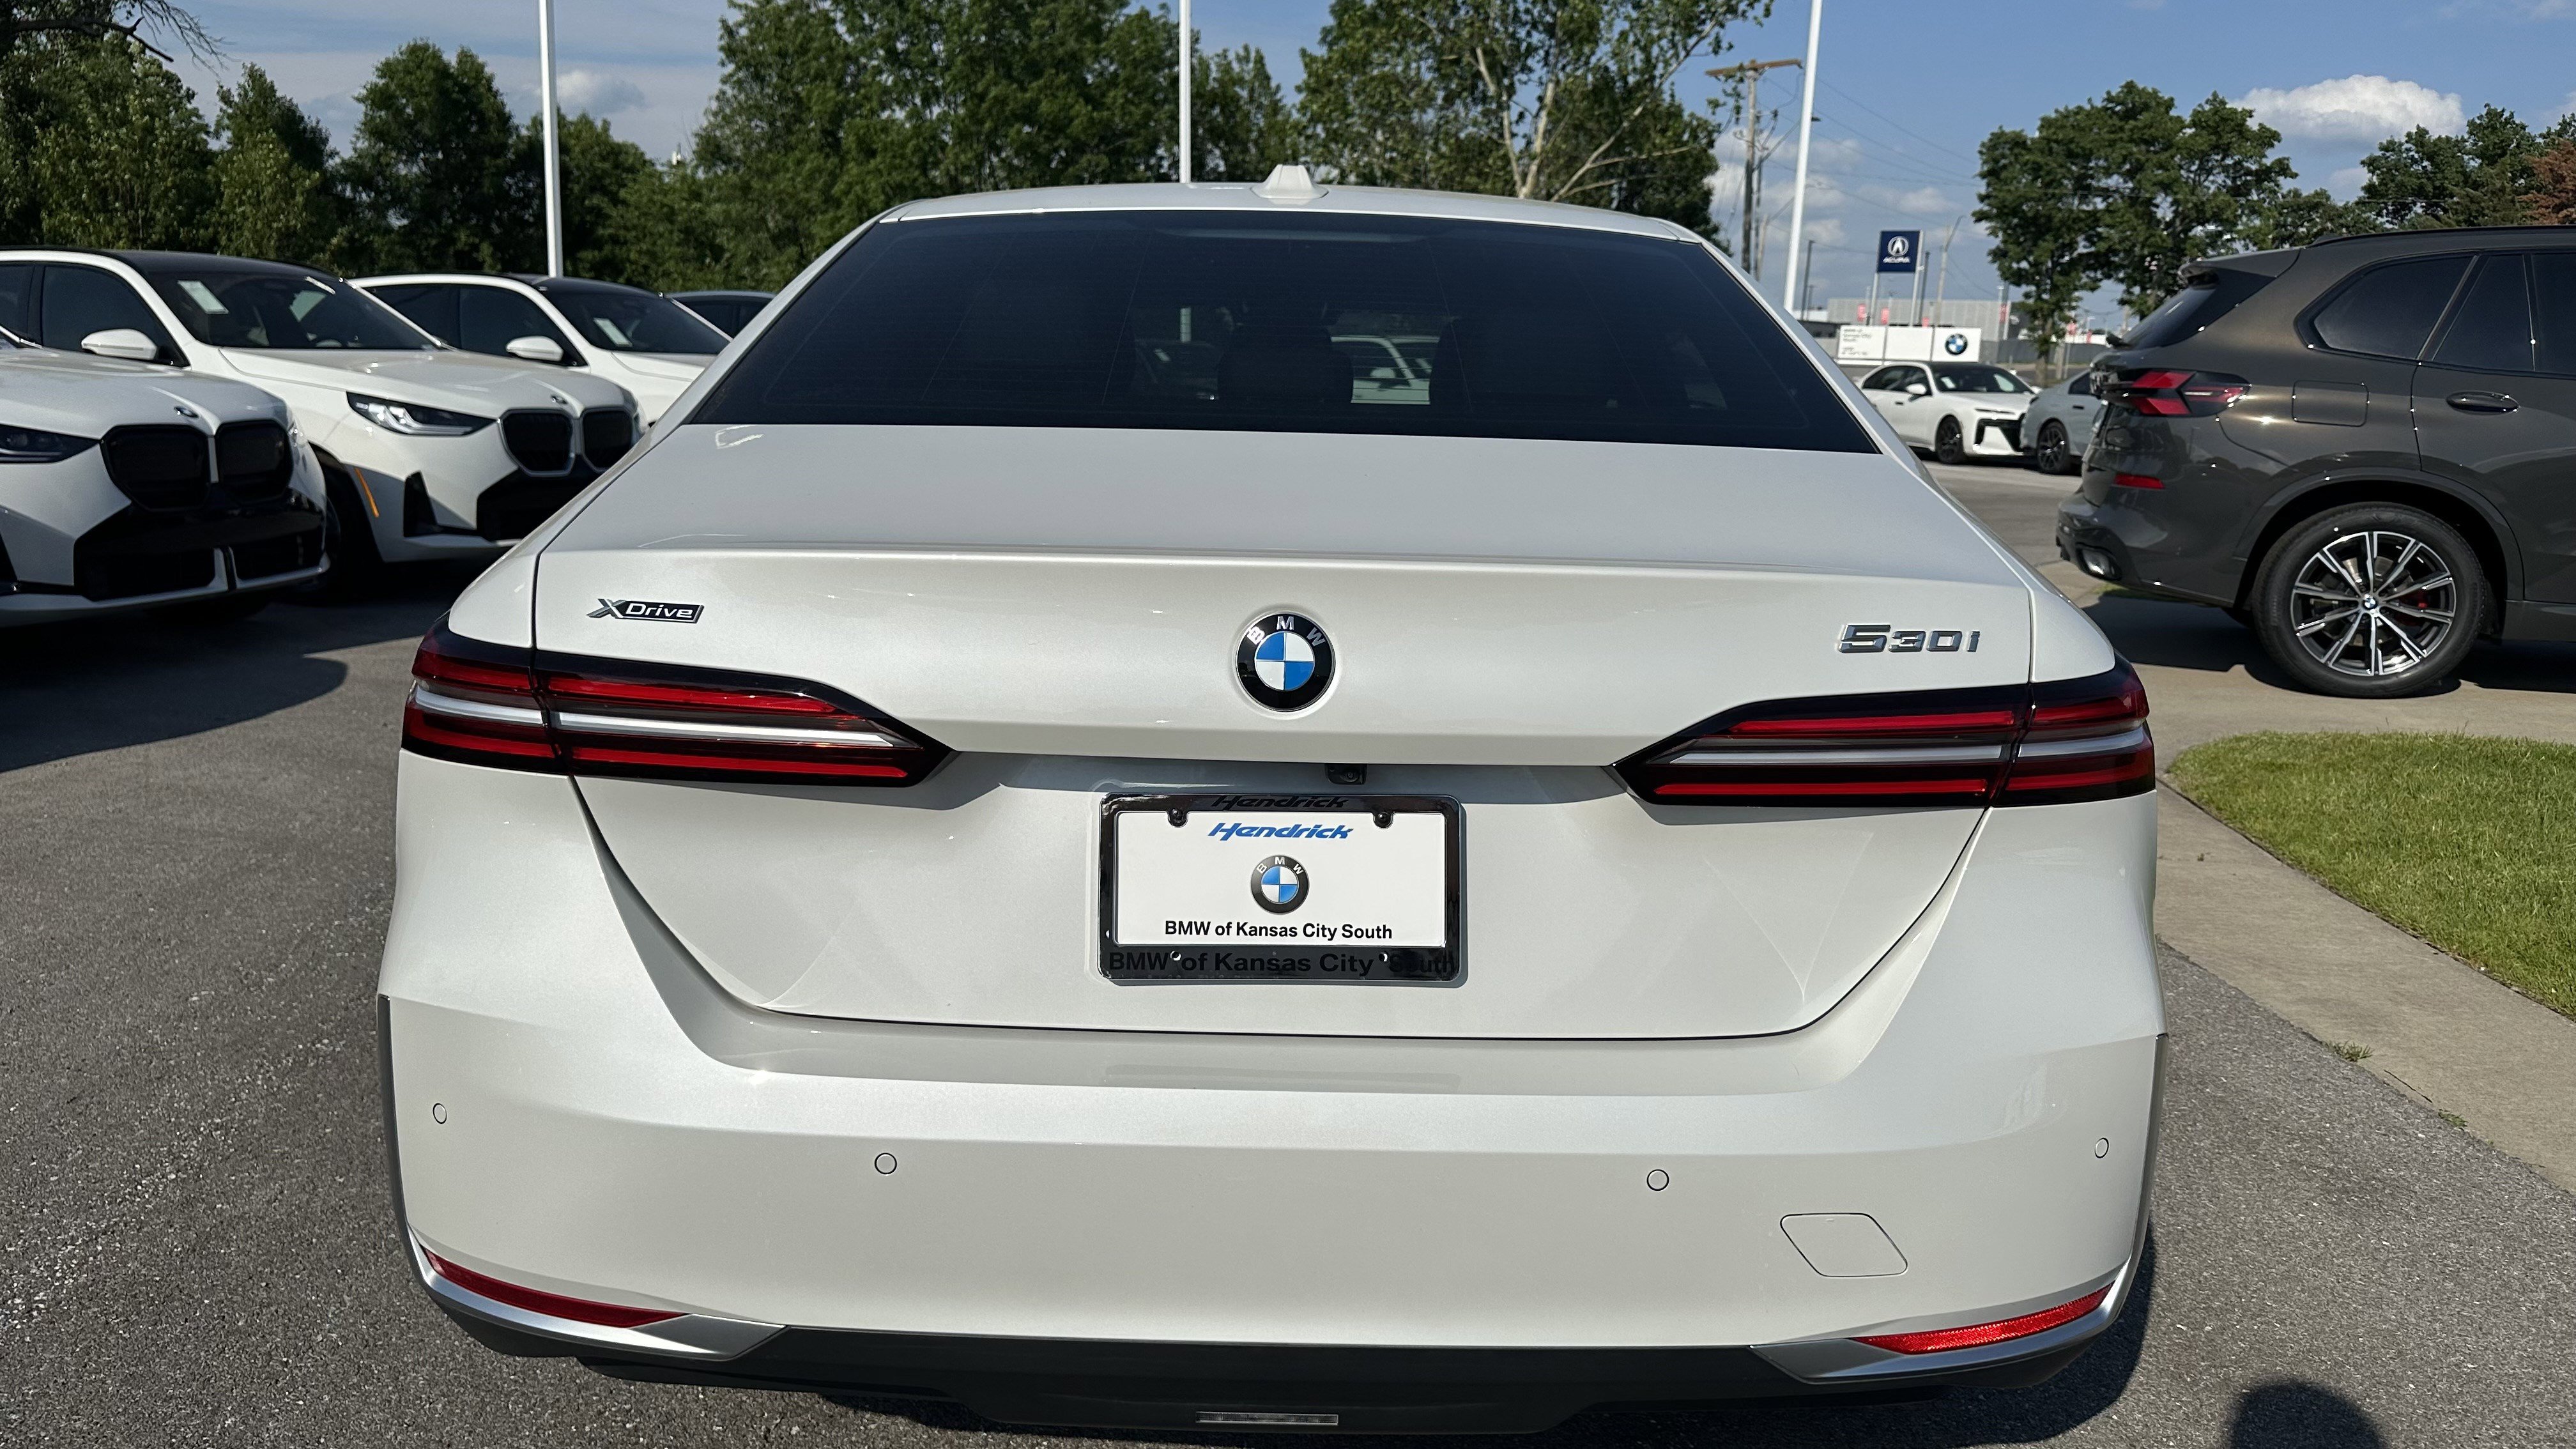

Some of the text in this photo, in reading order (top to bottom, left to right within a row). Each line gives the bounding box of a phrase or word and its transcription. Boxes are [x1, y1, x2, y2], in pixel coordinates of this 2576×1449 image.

[1247, 616, 1326, 647] BMW
[1838, 624, 1981, 653] 530i
[1211, 795, 1349, 811] Hendrick
[1208, 822, 1354, 841] Hendrick
[1256, 856, 1304, 875] BMW
[1165, 920, 1392, 941] BMW of Kansas City South
[1109, 952, 1169, 970] BMW
[1182, 953, 1208, 971] of
[1215, 953, 1310, 972] Kansas
[1319, 953, 1374, 976] City
